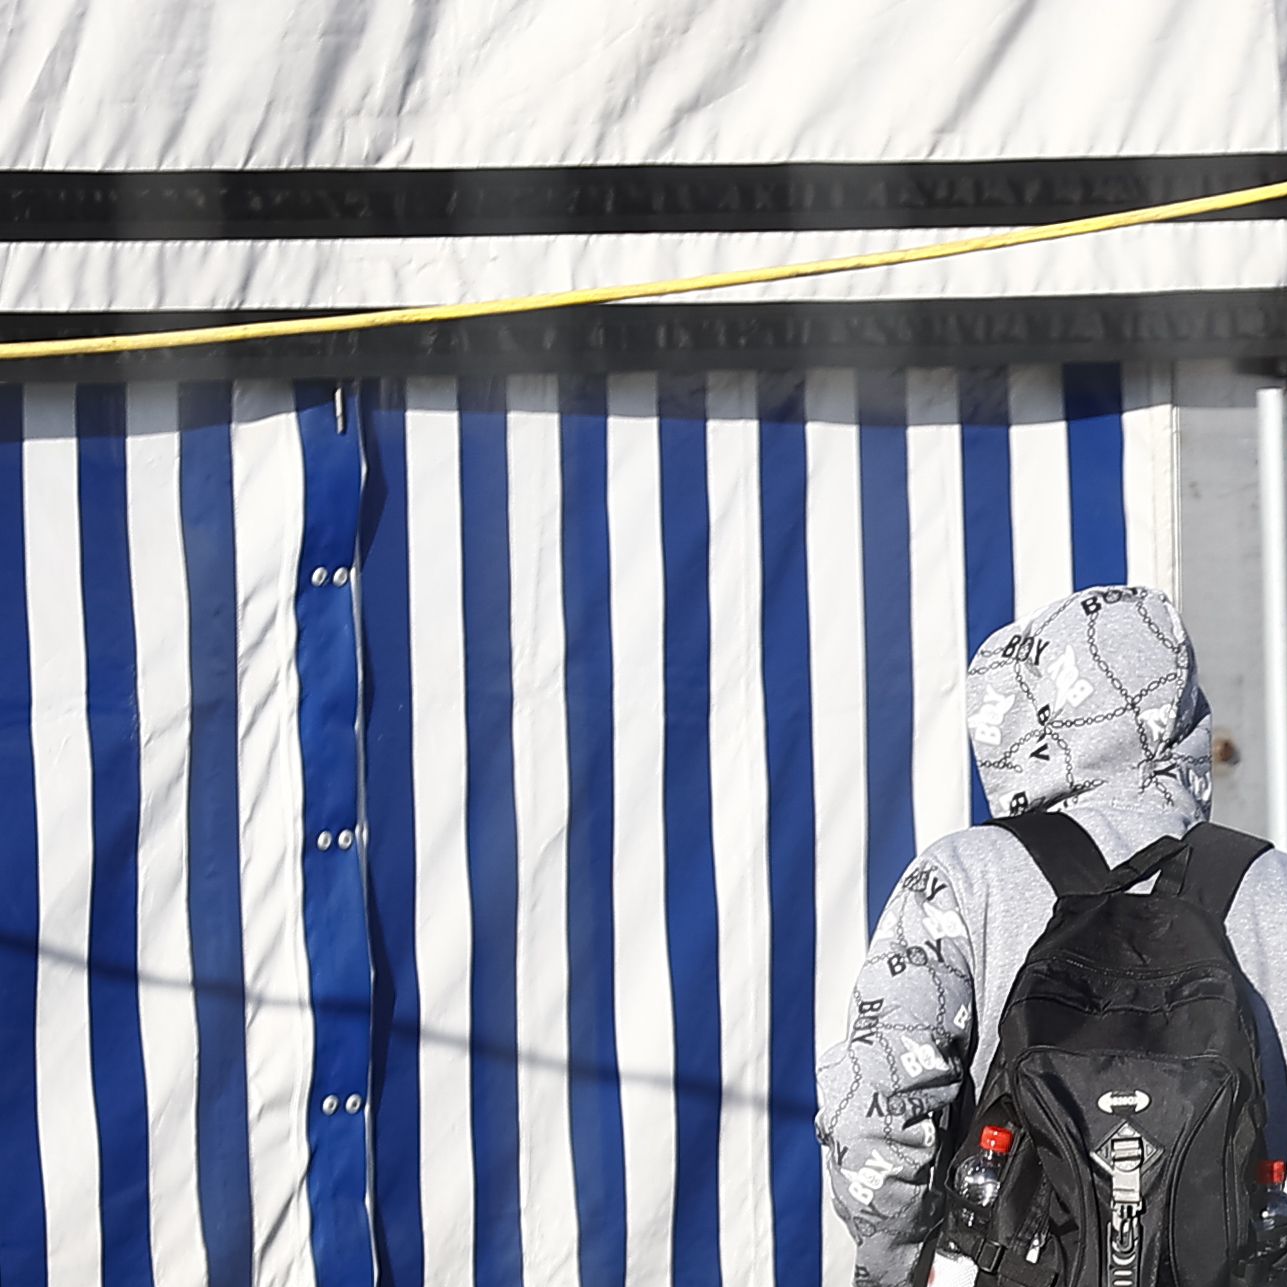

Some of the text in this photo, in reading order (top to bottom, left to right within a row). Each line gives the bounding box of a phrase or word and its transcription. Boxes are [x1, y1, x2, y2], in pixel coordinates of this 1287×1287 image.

[1001, 634, 1050, 666] BOY
[887, 938, 945, 977] BOY
[850, 998, 884, 1047] BOY
[848, 1149, 893, 1205] BOY
